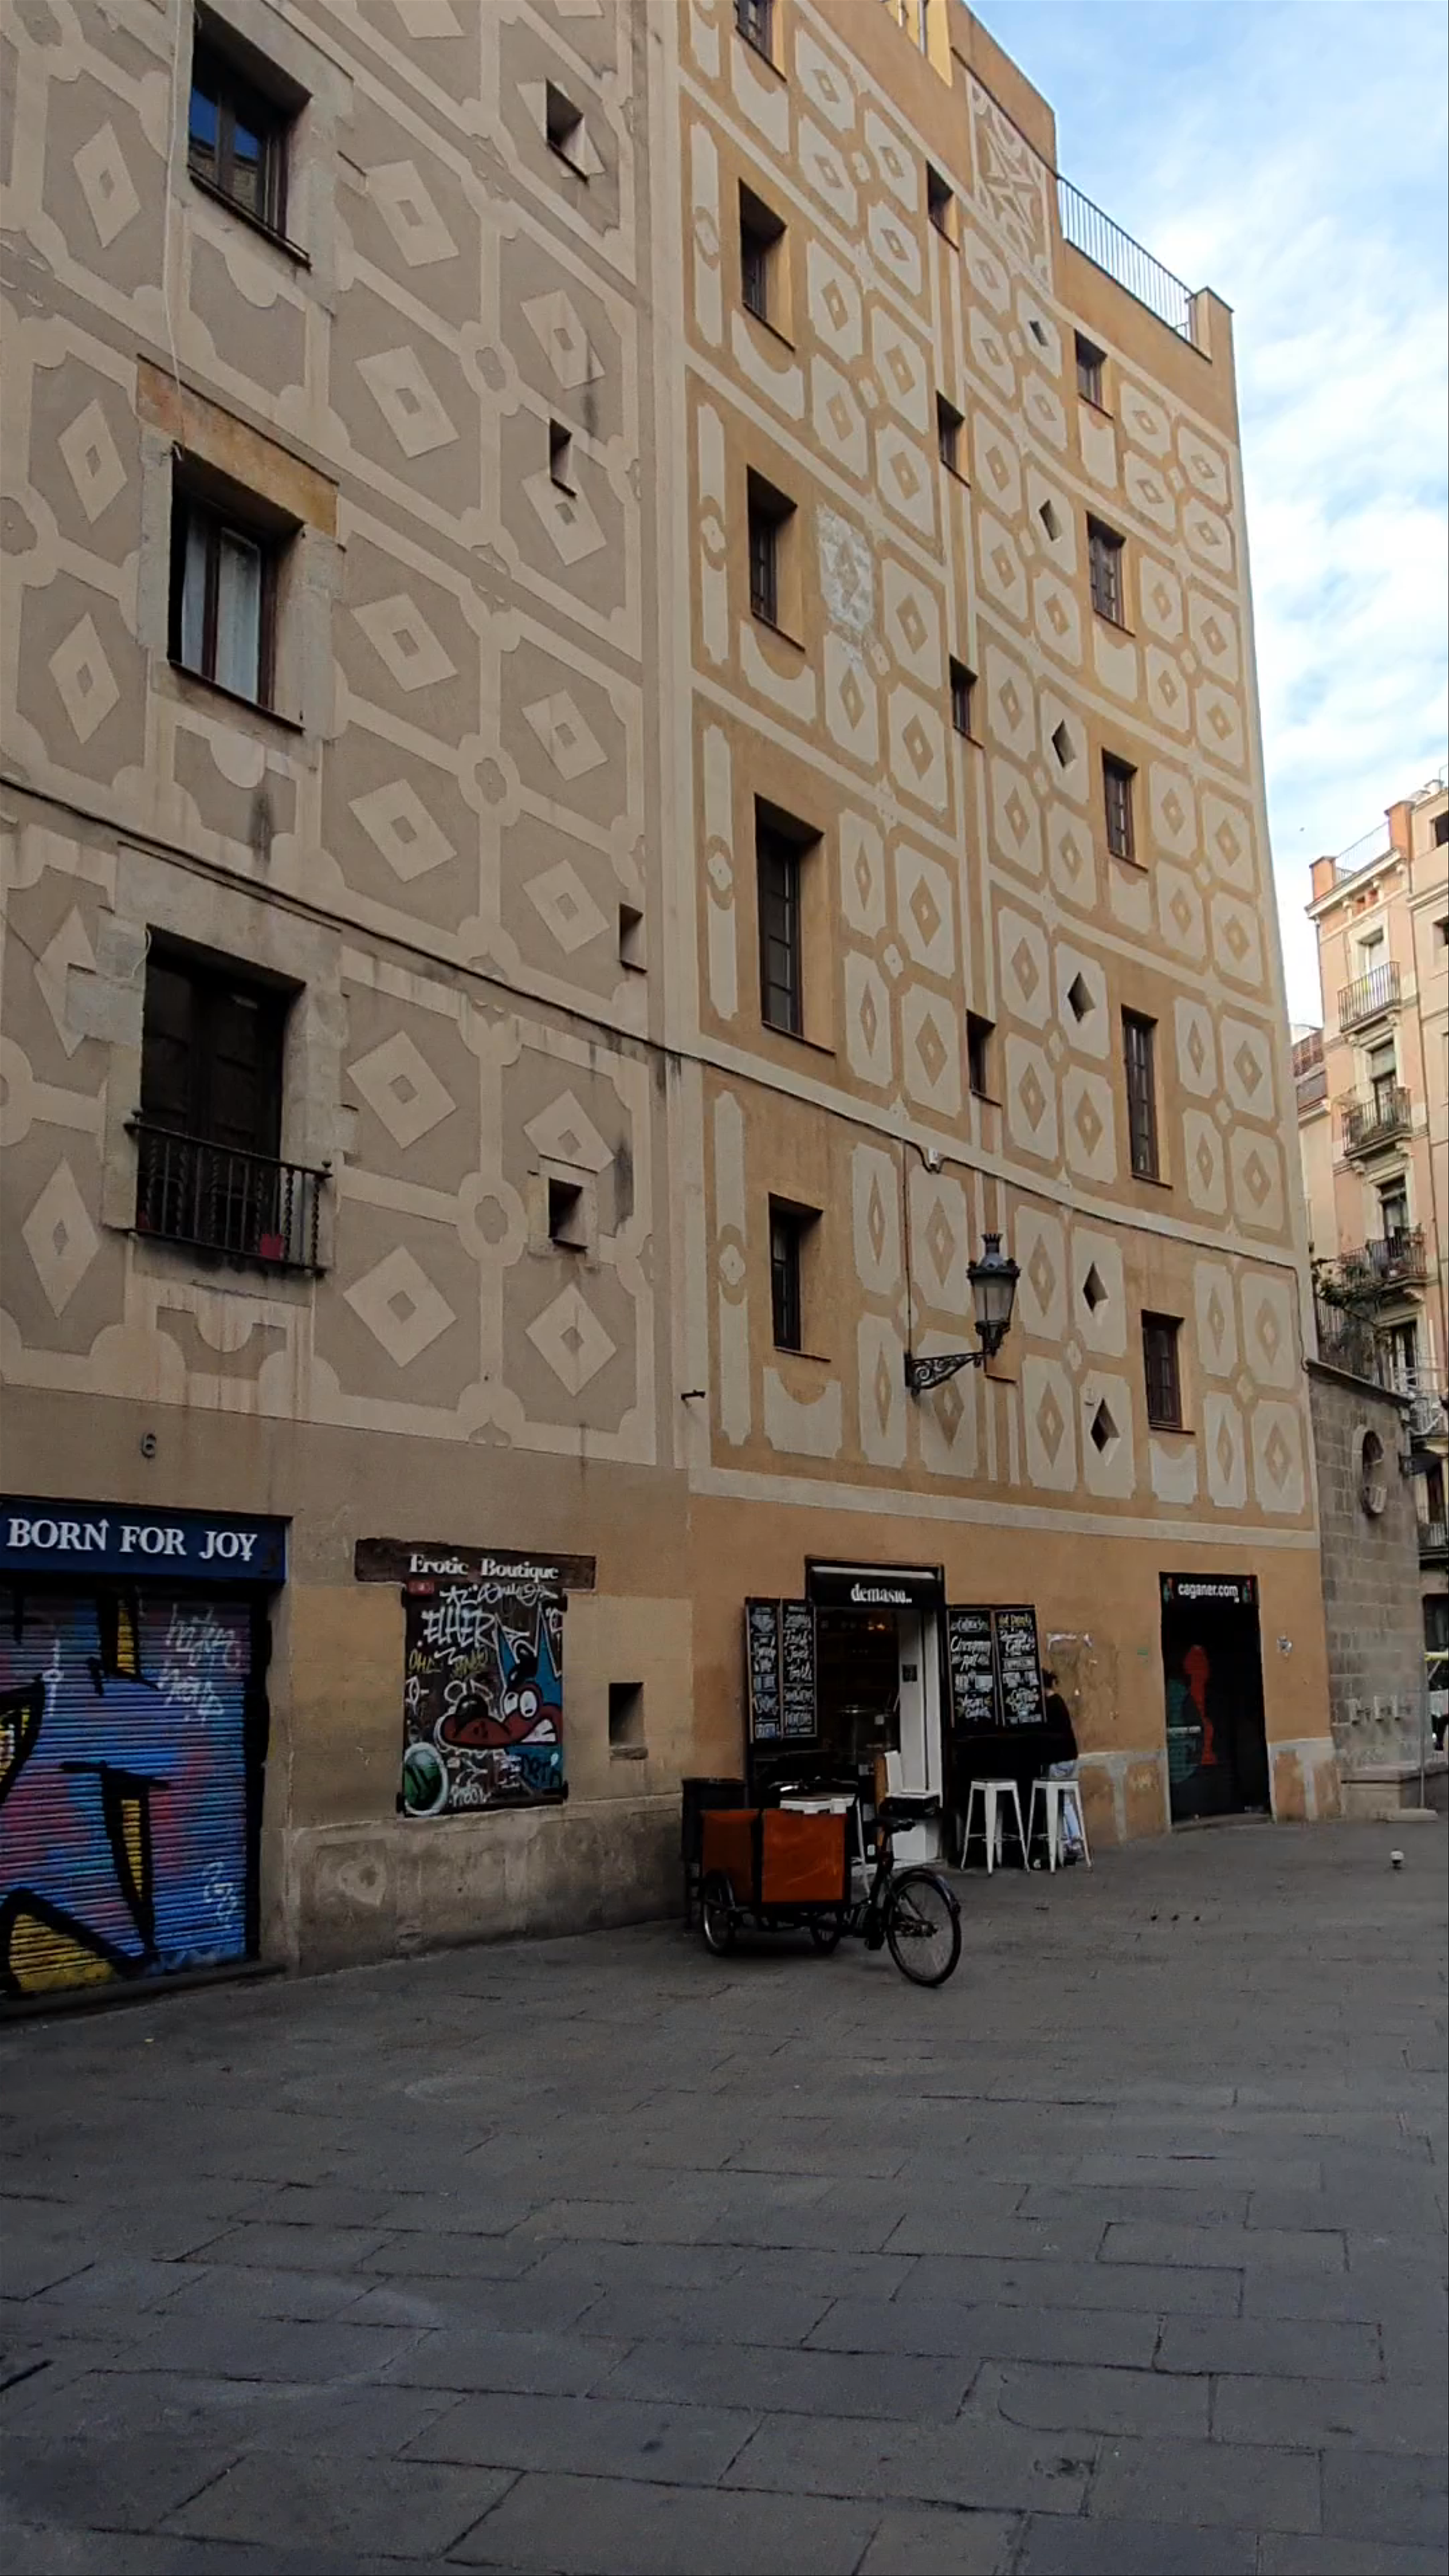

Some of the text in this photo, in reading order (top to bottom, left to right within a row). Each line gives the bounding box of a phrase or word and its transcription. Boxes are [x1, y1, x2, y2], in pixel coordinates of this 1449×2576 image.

[6, 1518, 258, 1561] BORN FOR JOY
[409, 1554, 559, 1583] Erotic Boutique
[1178, 1583, 1238, 1599] caganer.com
